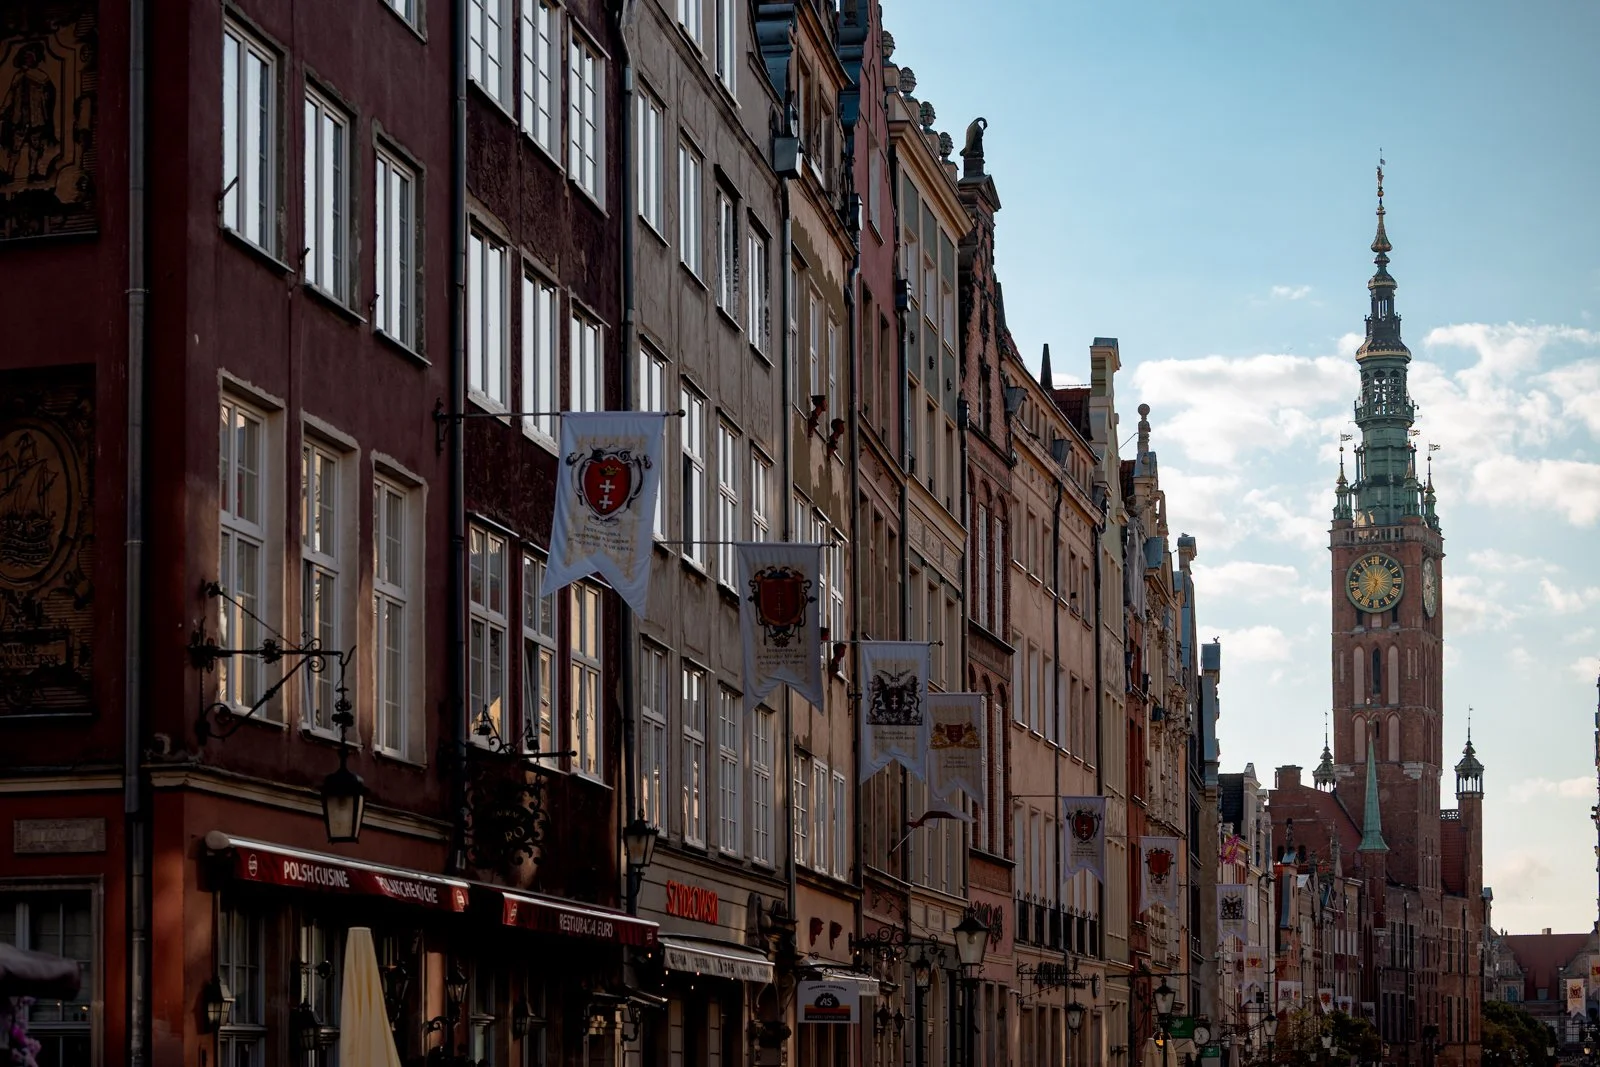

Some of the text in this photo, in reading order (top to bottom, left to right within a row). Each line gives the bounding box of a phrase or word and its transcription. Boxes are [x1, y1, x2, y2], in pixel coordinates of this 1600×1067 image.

[283, 860, 314, 882] POLSH
[314, 866, 350, 888] CUISINE
[597, 920, 615, 938] EURO
